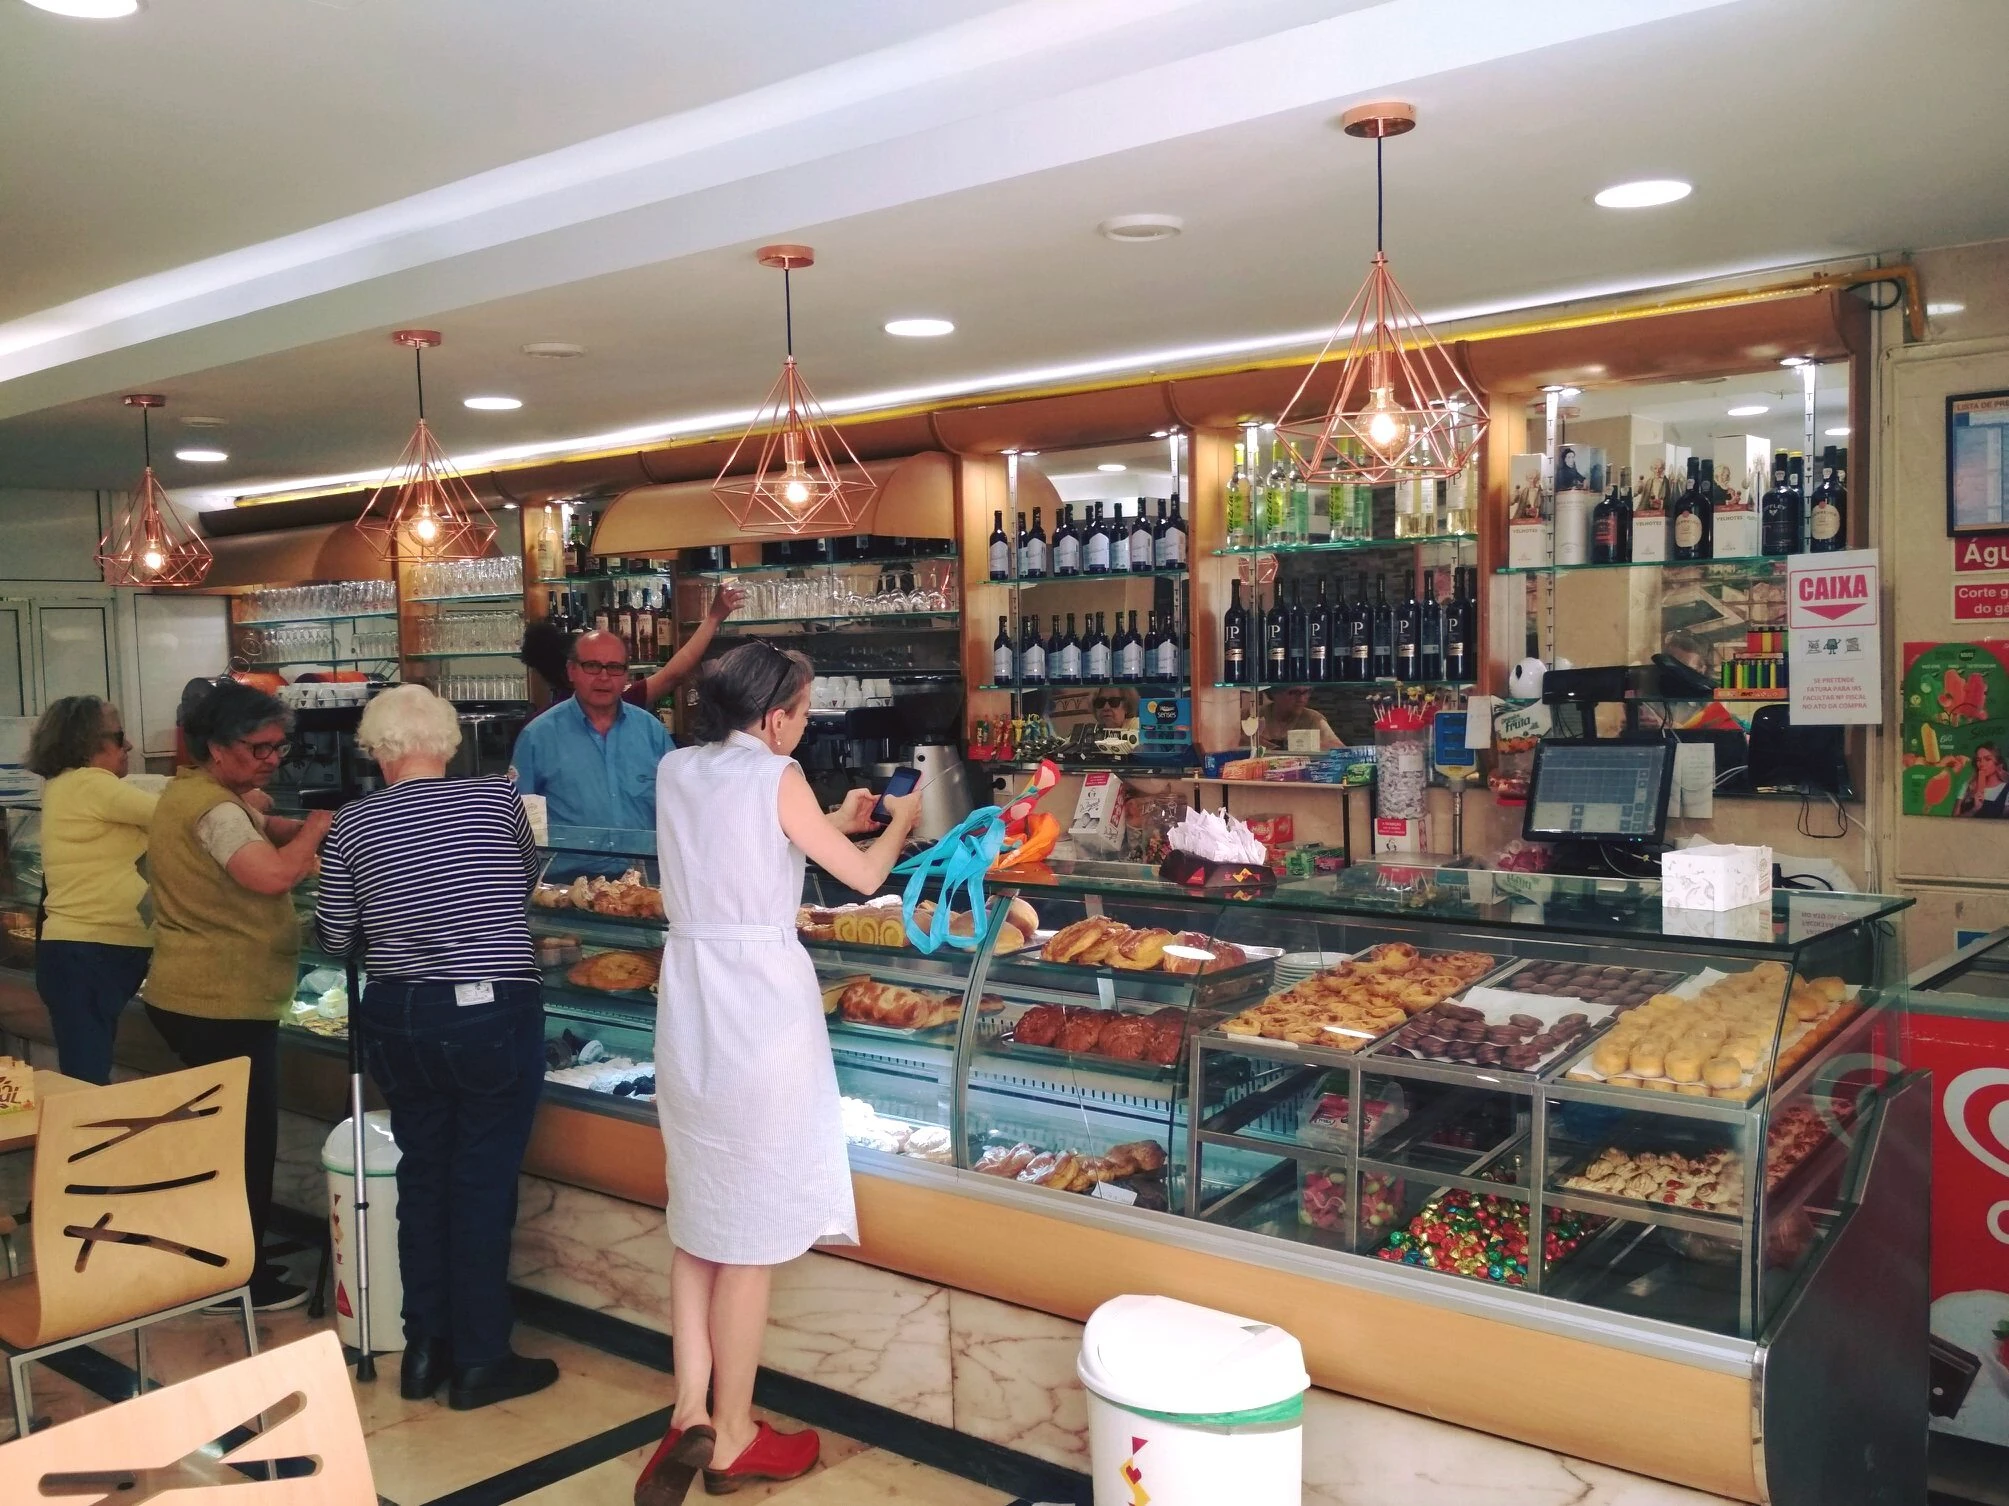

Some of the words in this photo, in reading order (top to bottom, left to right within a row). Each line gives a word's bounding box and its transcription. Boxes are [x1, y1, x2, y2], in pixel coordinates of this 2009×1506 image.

[1963, 537, 2009, 568] Águ
[1798, 574, 1868, 602] CAIXA
[1959, 587, 1997, 598] Corte
[1974, 602, 1992, 614] do
